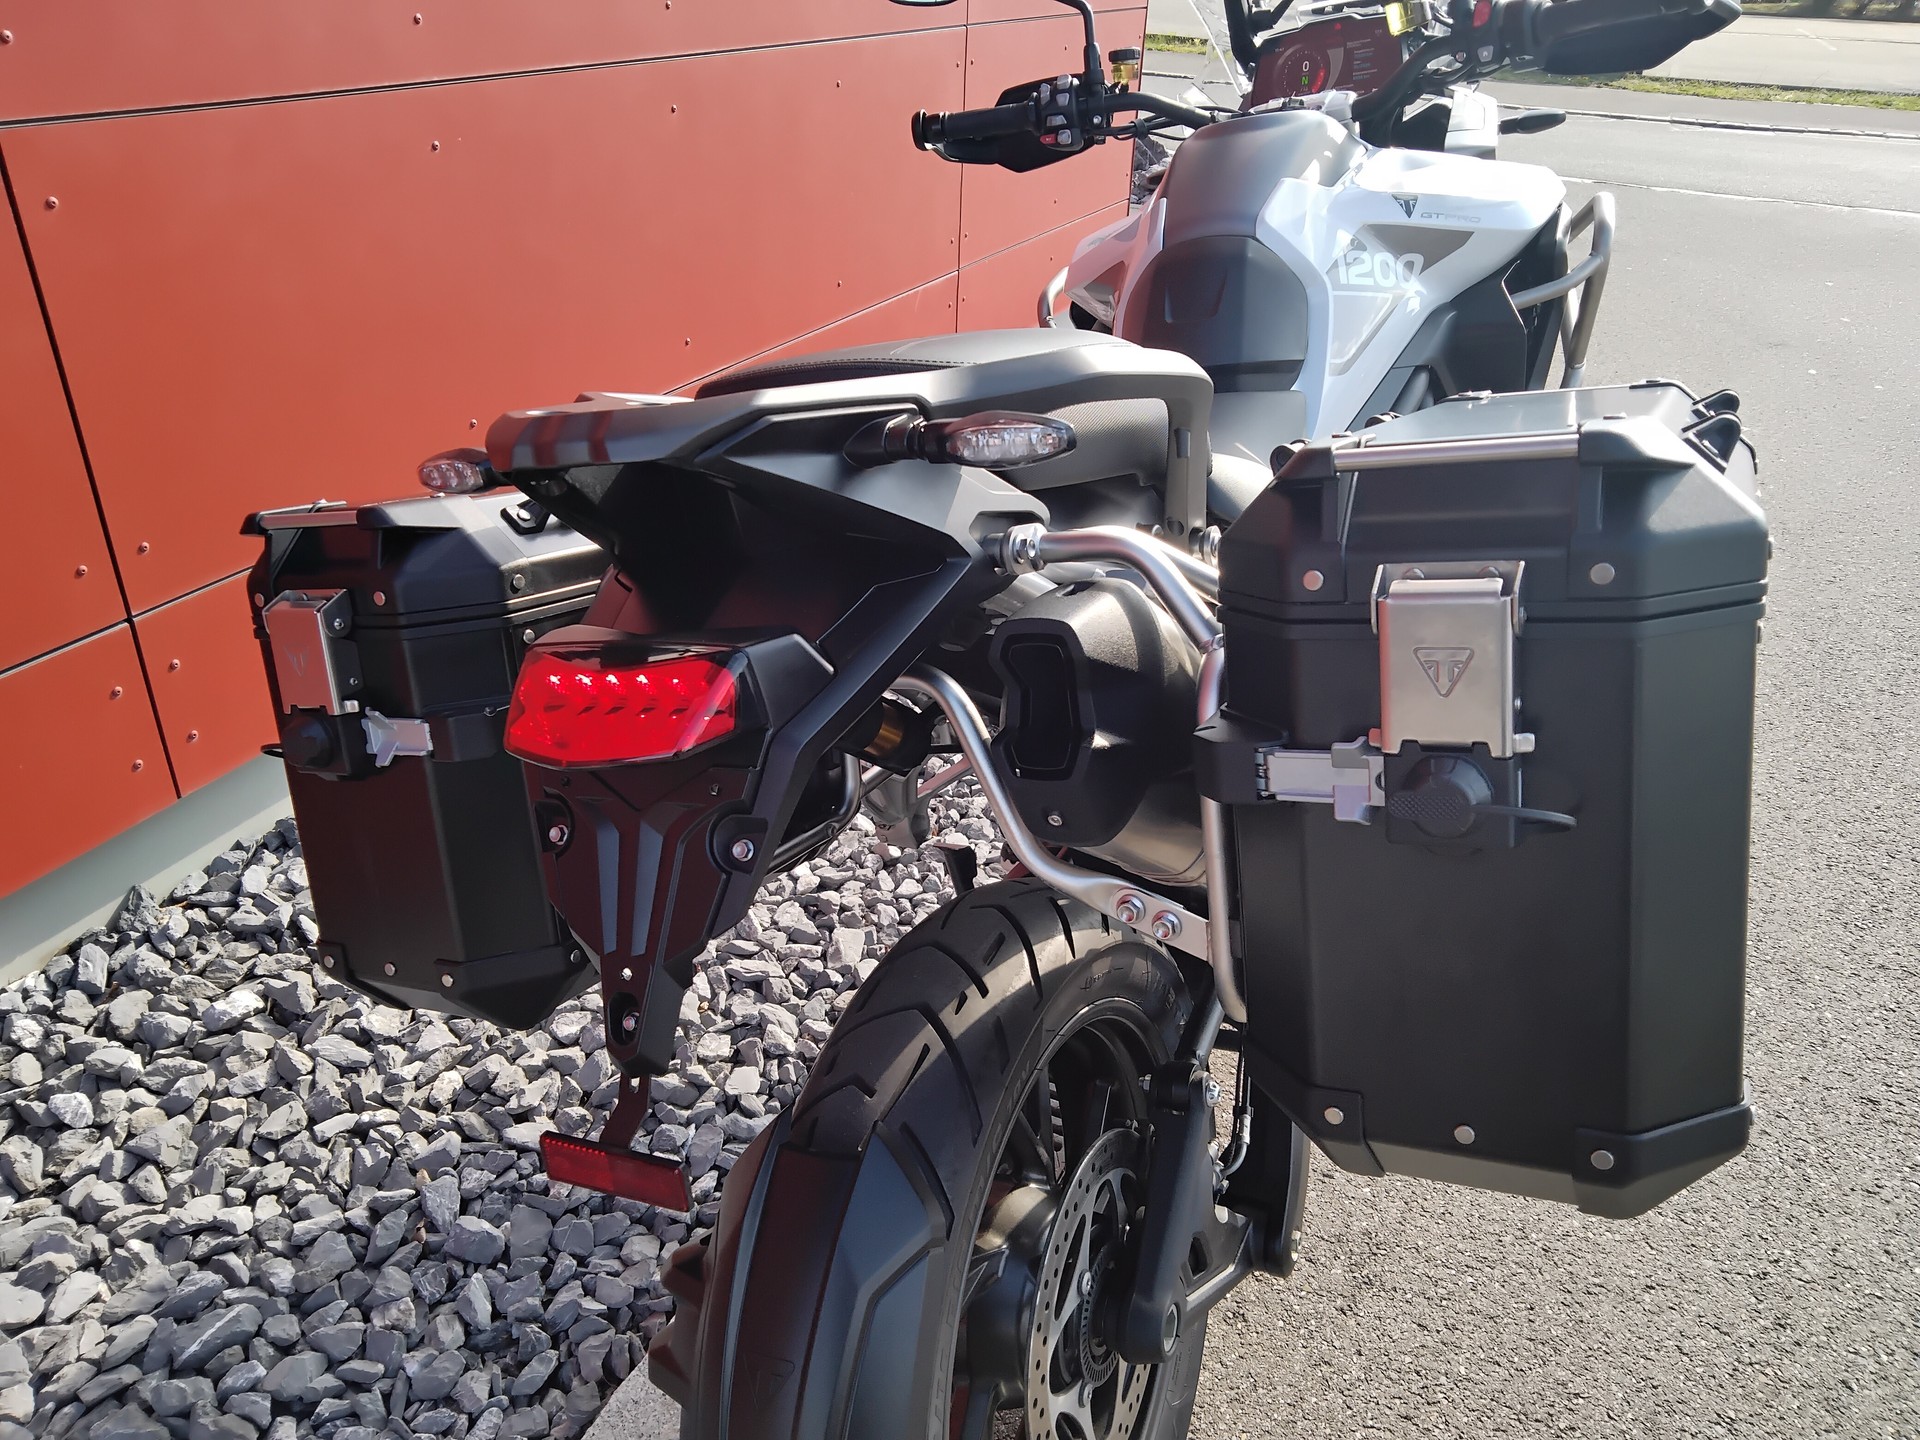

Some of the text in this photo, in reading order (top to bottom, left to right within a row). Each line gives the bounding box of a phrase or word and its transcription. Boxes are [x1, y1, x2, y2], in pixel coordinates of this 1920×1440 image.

[1302, 61, 1310, 72] 0
[1301, 76, 1309, 86] N
[1337, 250, 1425, 288] 1200
